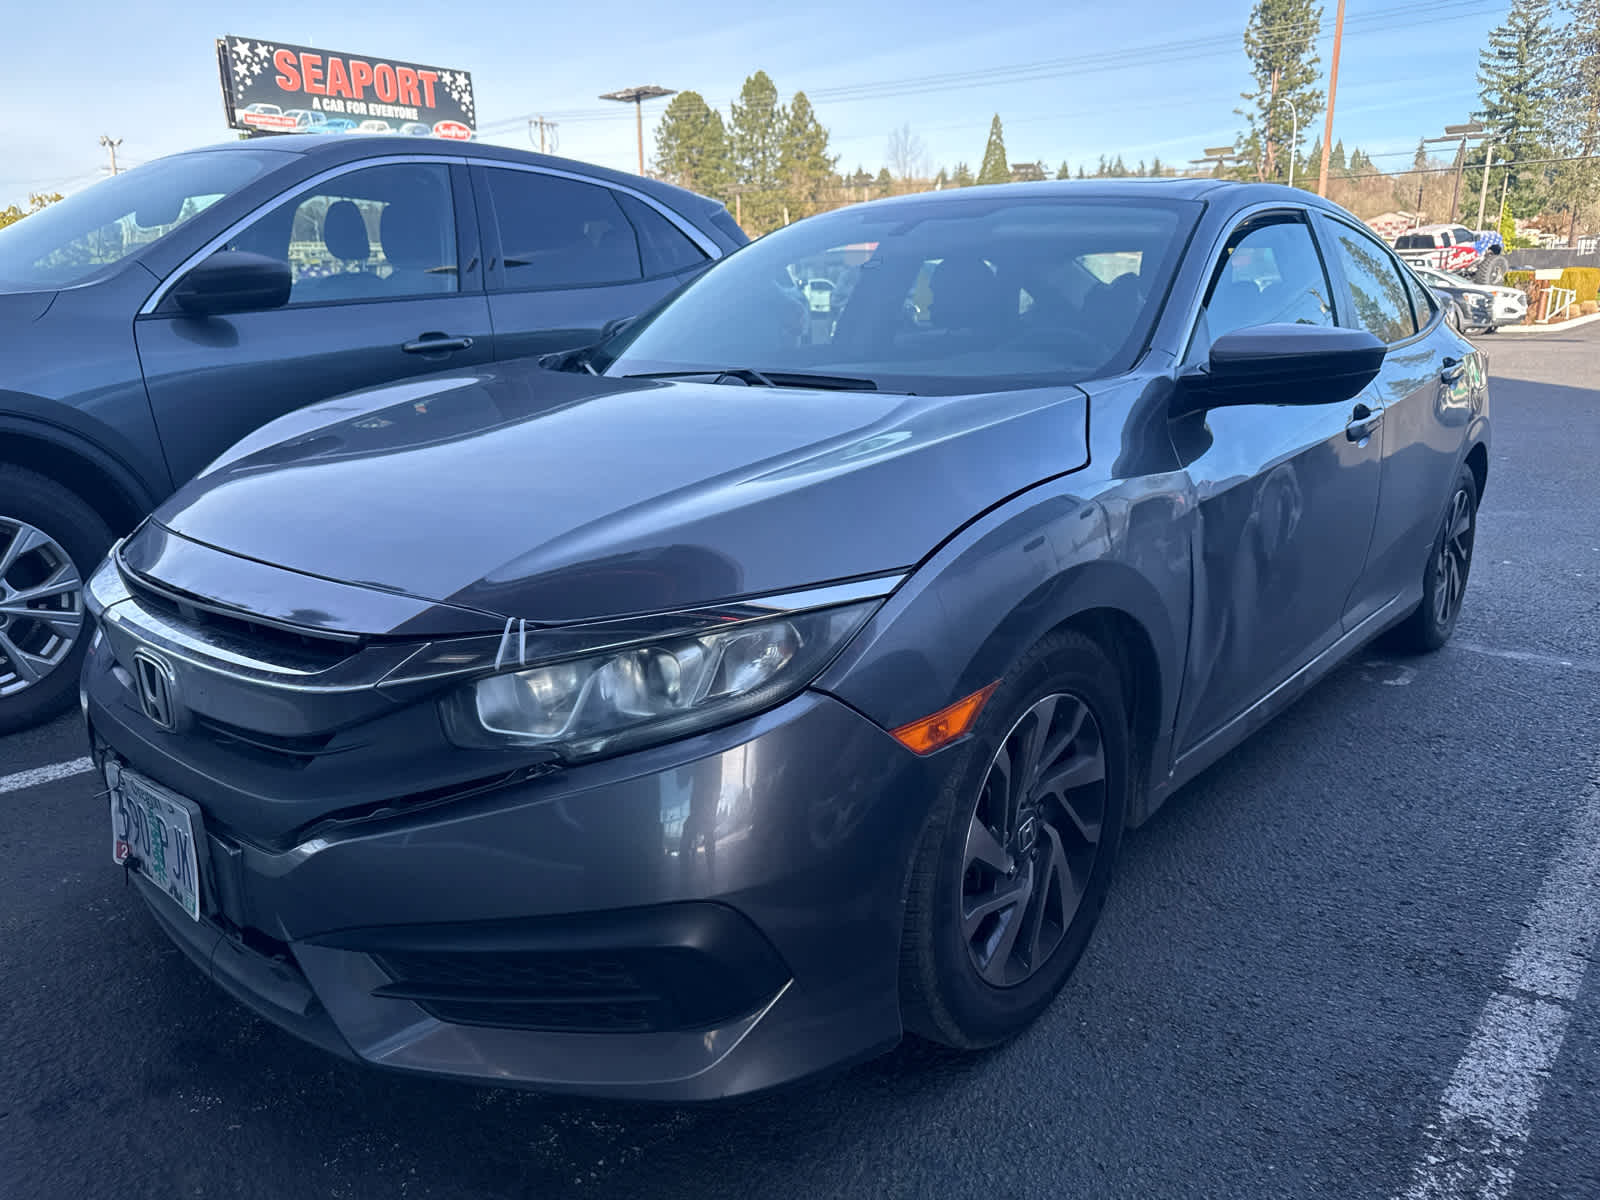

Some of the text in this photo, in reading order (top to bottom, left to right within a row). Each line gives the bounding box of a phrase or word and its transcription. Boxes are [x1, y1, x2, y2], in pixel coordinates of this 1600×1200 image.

[273, 49, 439, 108] SEAPORT
[312, 97, 419, 120] A CAR FOR EVERYONE
